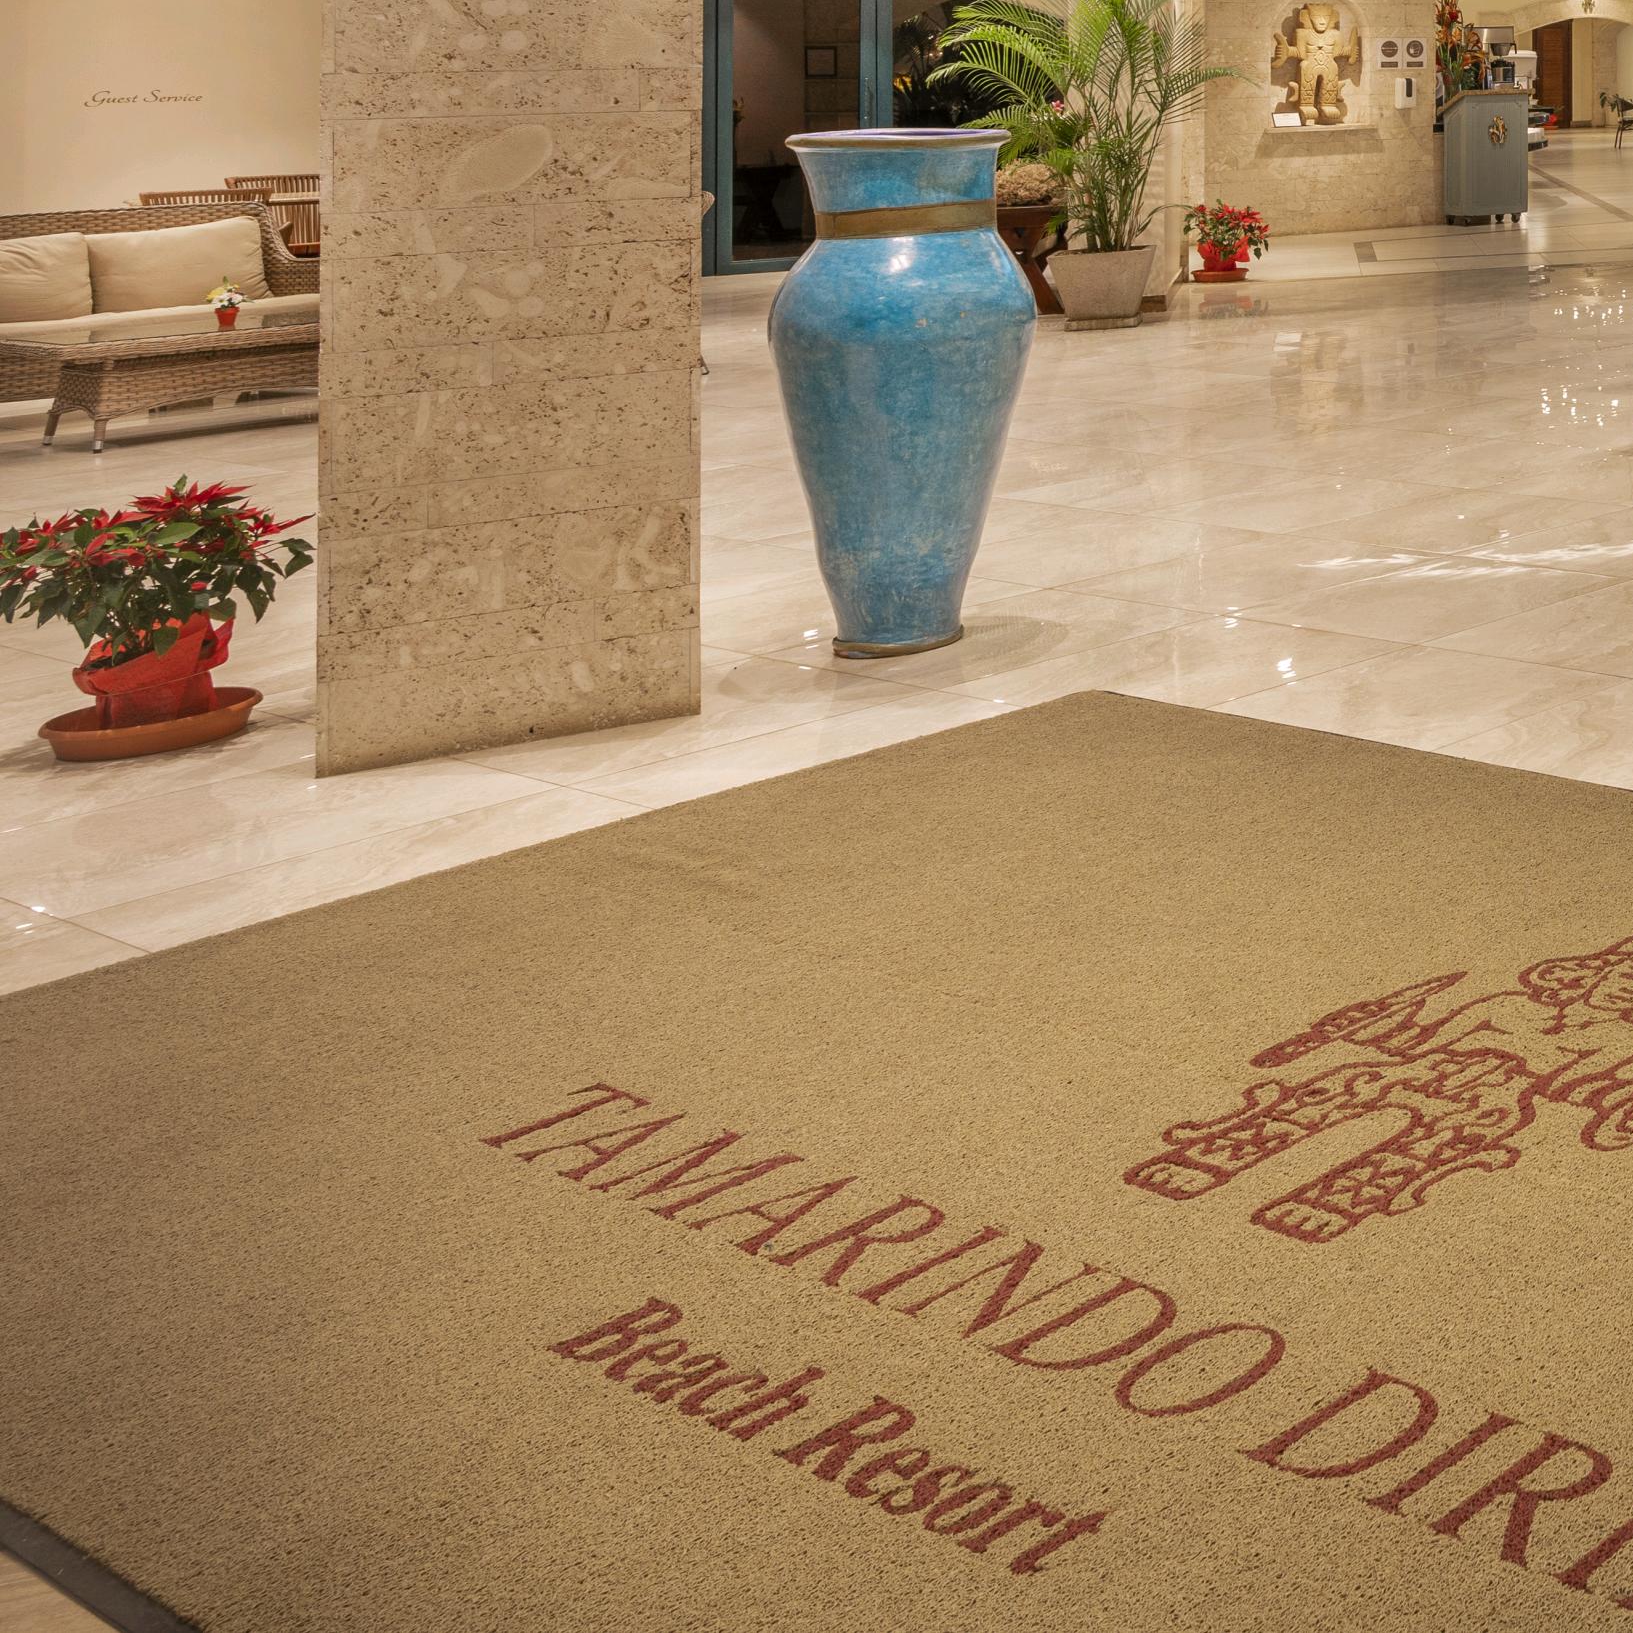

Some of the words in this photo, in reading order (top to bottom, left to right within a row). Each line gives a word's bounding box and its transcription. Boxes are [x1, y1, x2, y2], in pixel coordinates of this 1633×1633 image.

[83, 90, 138, 108] Guest
[143, 89, 203, 103] Service
[480, 1082, 1287, 1418] TAMARINDO
[546, 1297, 826, 1442] Beach
[772, 1394, 1112, 1575] Resort
